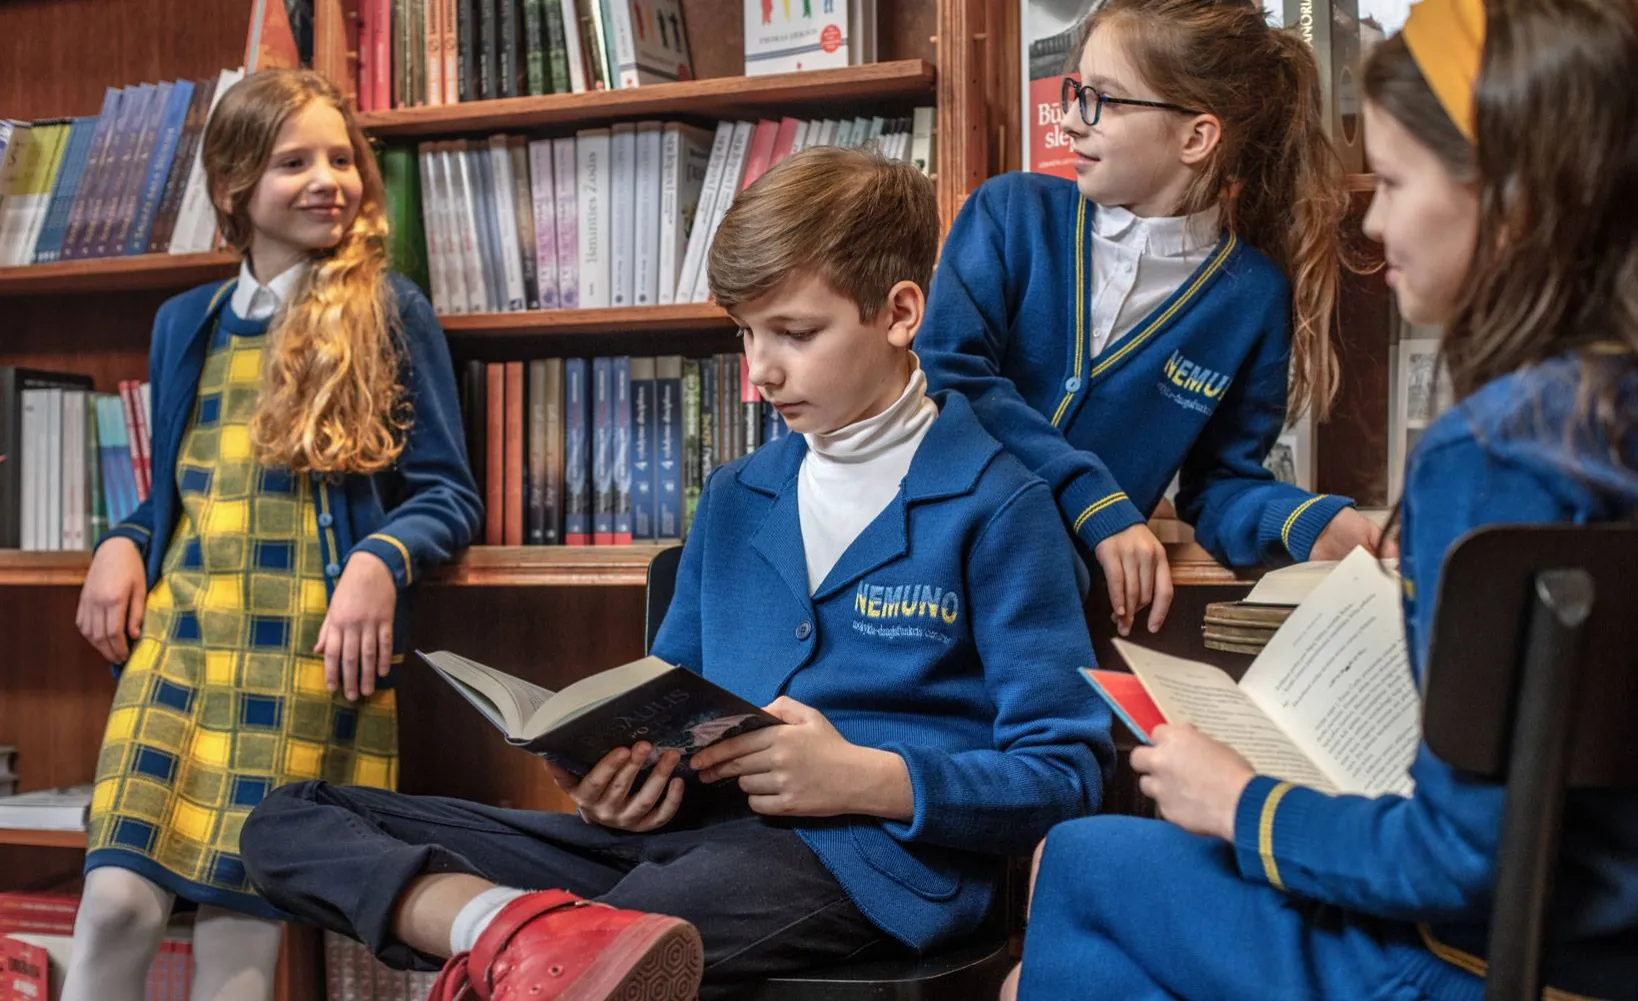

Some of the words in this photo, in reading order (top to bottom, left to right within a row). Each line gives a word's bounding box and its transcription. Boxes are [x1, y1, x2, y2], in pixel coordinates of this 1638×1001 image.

[1037, 102, 1063, 126] Bū
[635, 460, 648, 471] 4
[660, 460, 674, 471] 4
[854, 580, 959, 625] NEMUNO
